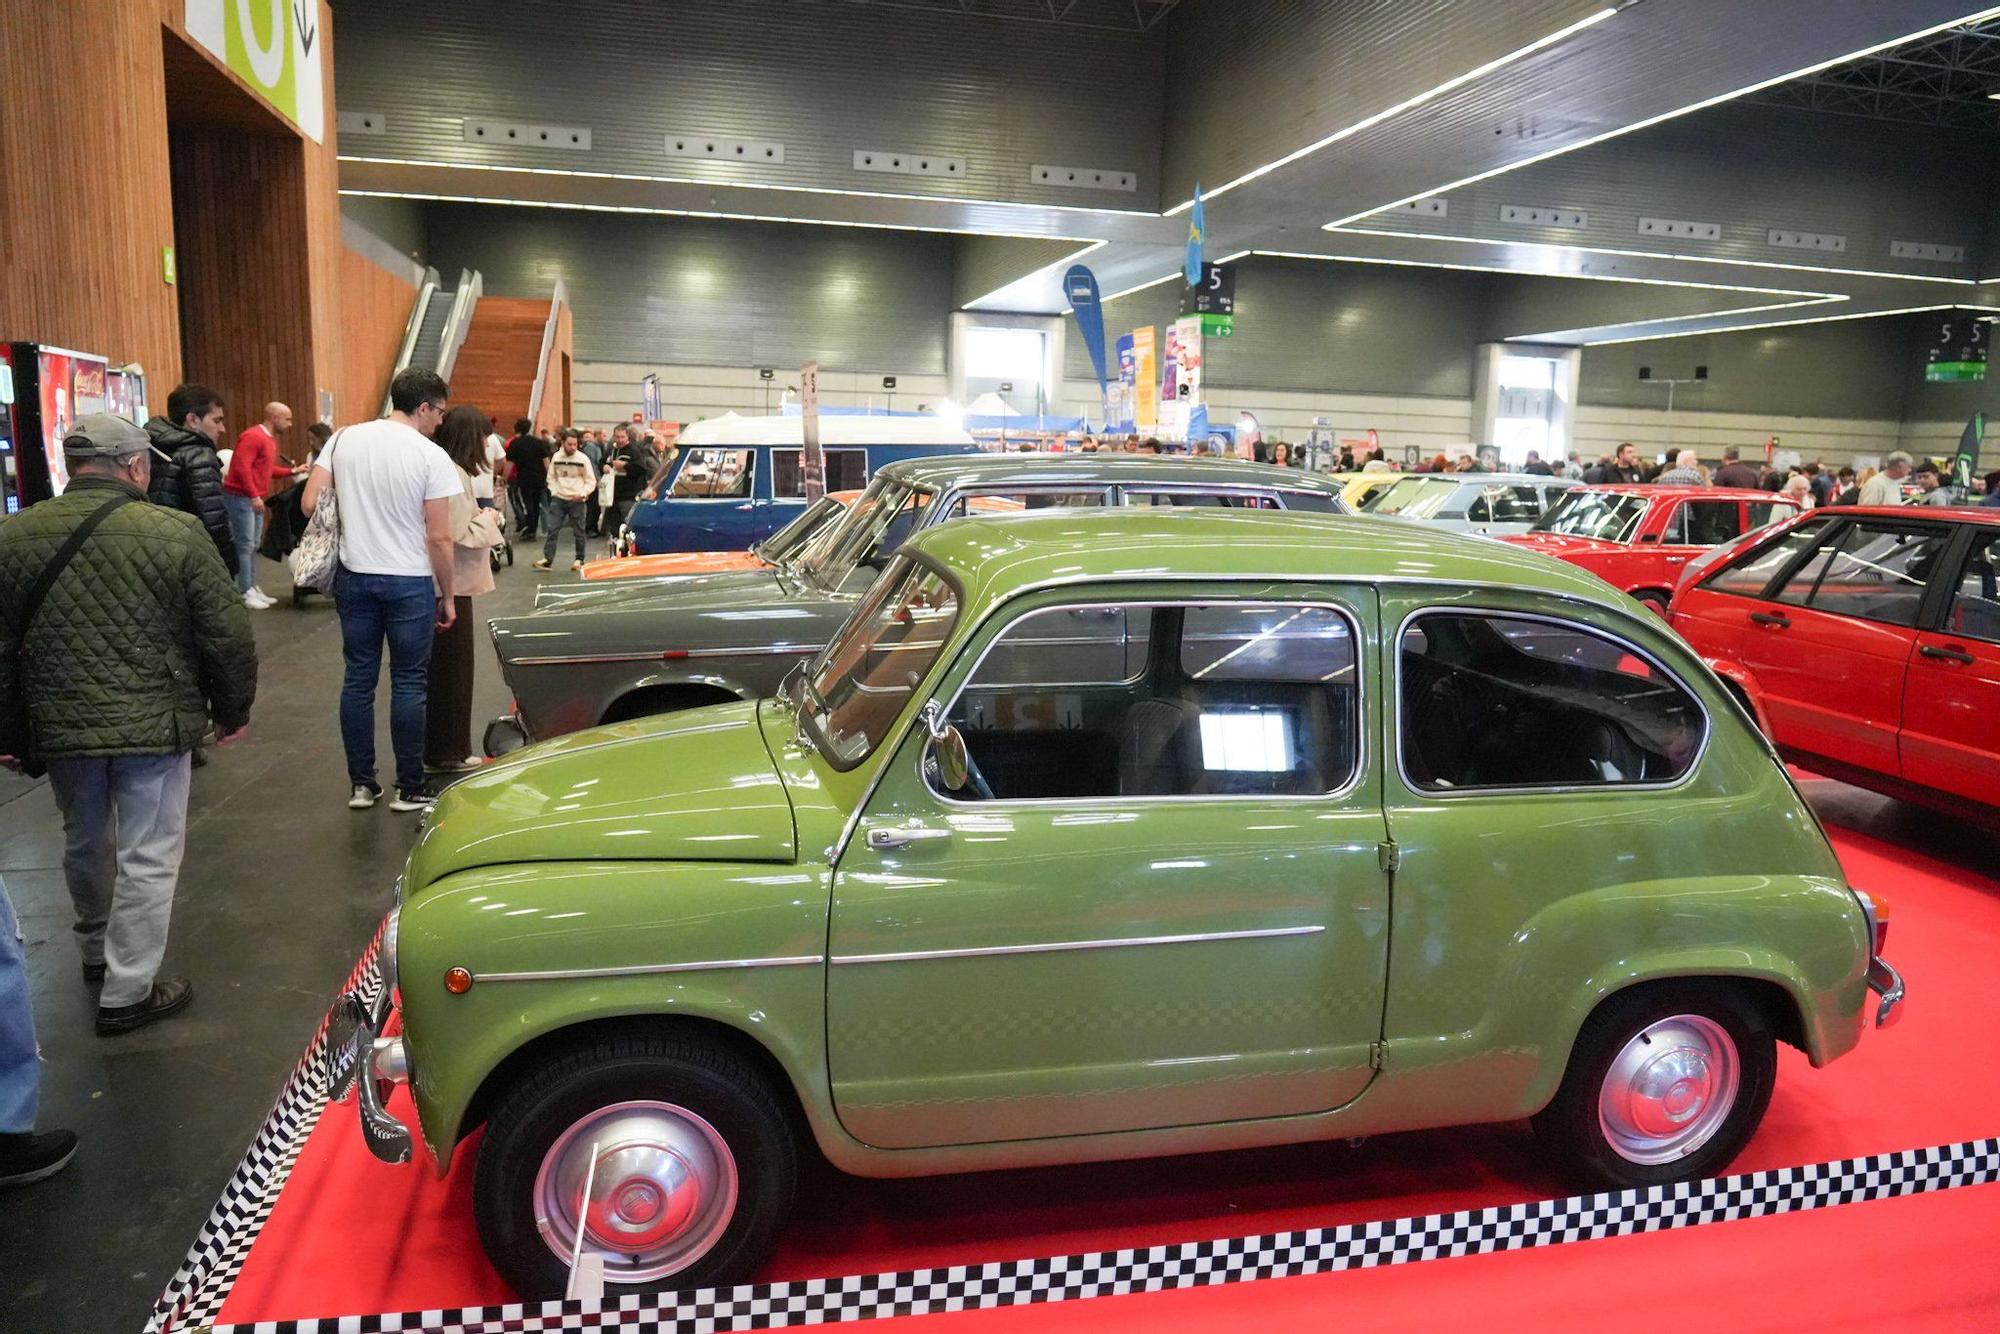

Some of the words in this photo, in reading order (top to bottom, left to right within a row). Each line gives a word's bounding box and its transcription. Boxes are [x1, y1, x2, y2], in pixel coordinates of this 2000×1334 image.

[1210, 268, 1222, 290] 5
[1941, 324, 1951, 343] 5
[1971, 324, 1981, 343] 5
